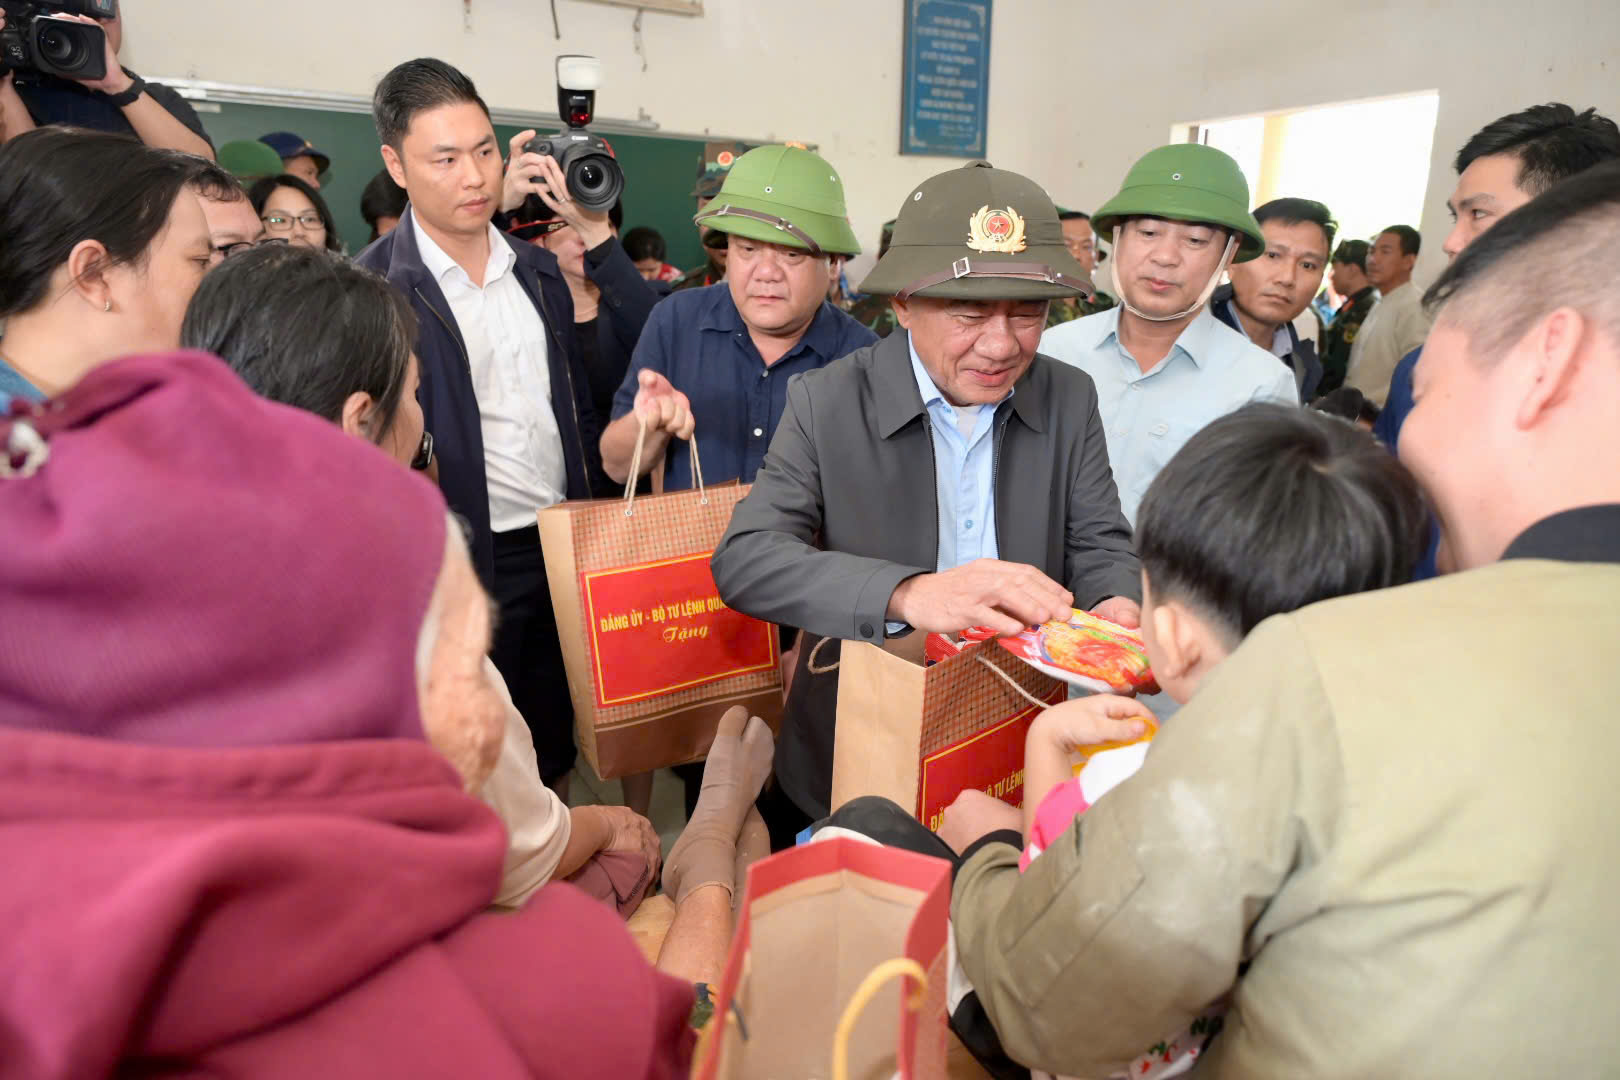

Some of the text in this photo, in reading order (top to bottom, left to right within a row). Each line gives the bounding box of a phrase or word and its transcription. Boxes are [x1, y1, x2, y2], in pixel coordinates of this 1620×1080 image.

[600, 613, 629, 632] ĐẢNG
[630, 608, 643, 626] ỦY
[652, 604, 666, 624] BỘ
[667, 603, 680, 620] TƯ
[680, 600, 706, 619] LỆNH
[662, 626, 708, 643] Tặng
[930, 806, 944, 832] ĐẢ
